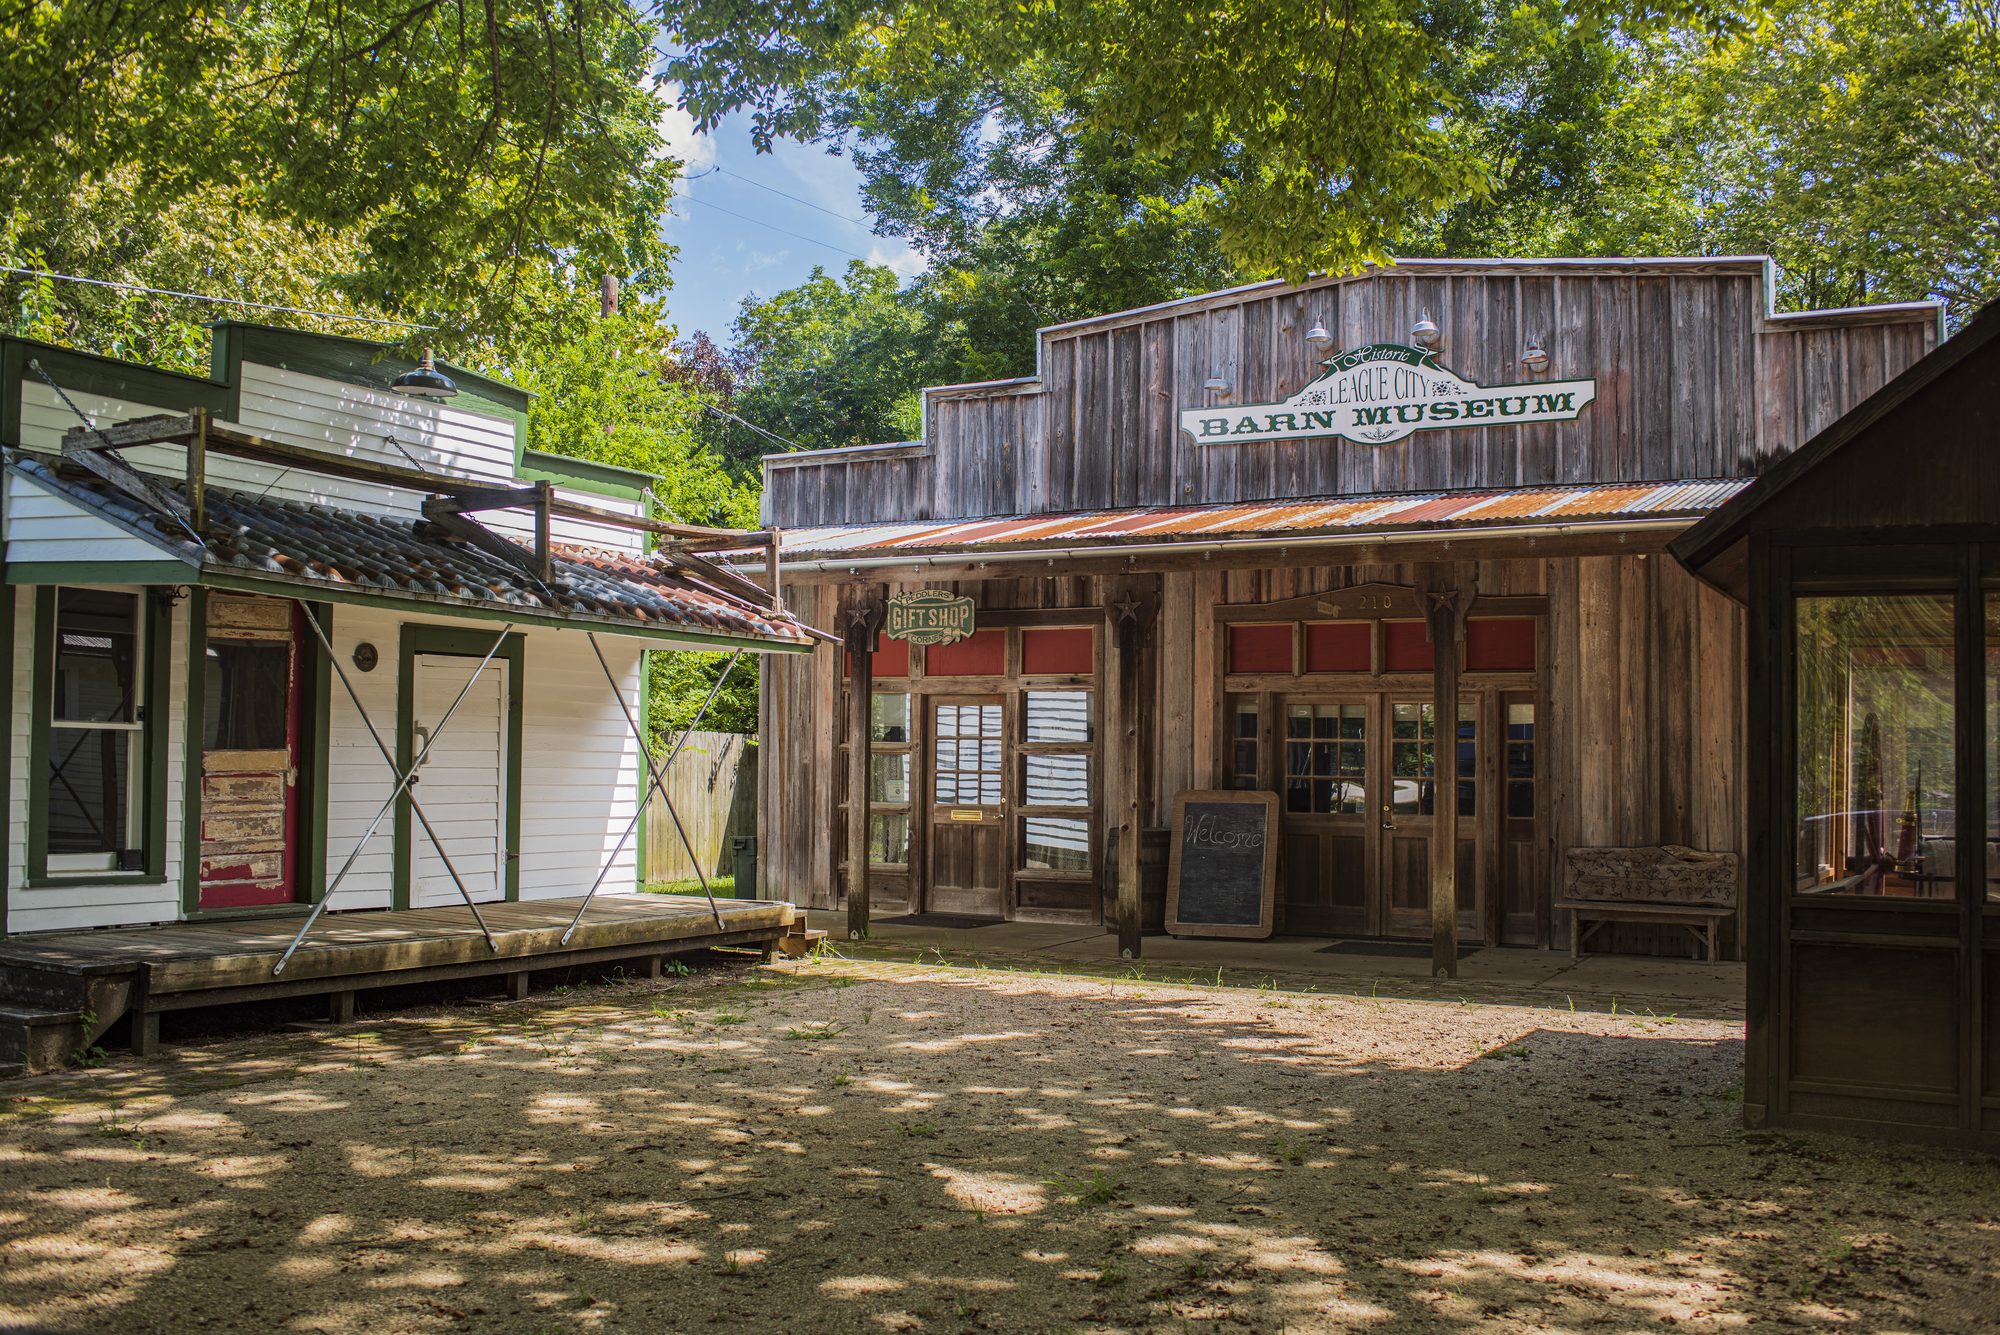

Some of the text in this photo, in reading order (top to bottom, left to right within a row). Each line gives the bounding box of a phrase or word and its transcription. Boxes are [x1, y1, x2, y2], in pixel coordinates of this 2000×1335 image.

[1344, 345, 1411, 367] Historic
[1330, 367, 1430, 404] LEAGUE CITY
[1199, 392, 1575, 437] BARN MUSEUM
[892, 605, 969, 630] GIFT SHOP
[1359, 596, 1392, 609] 210
[1185, 812, 1264, 849] Welcome
